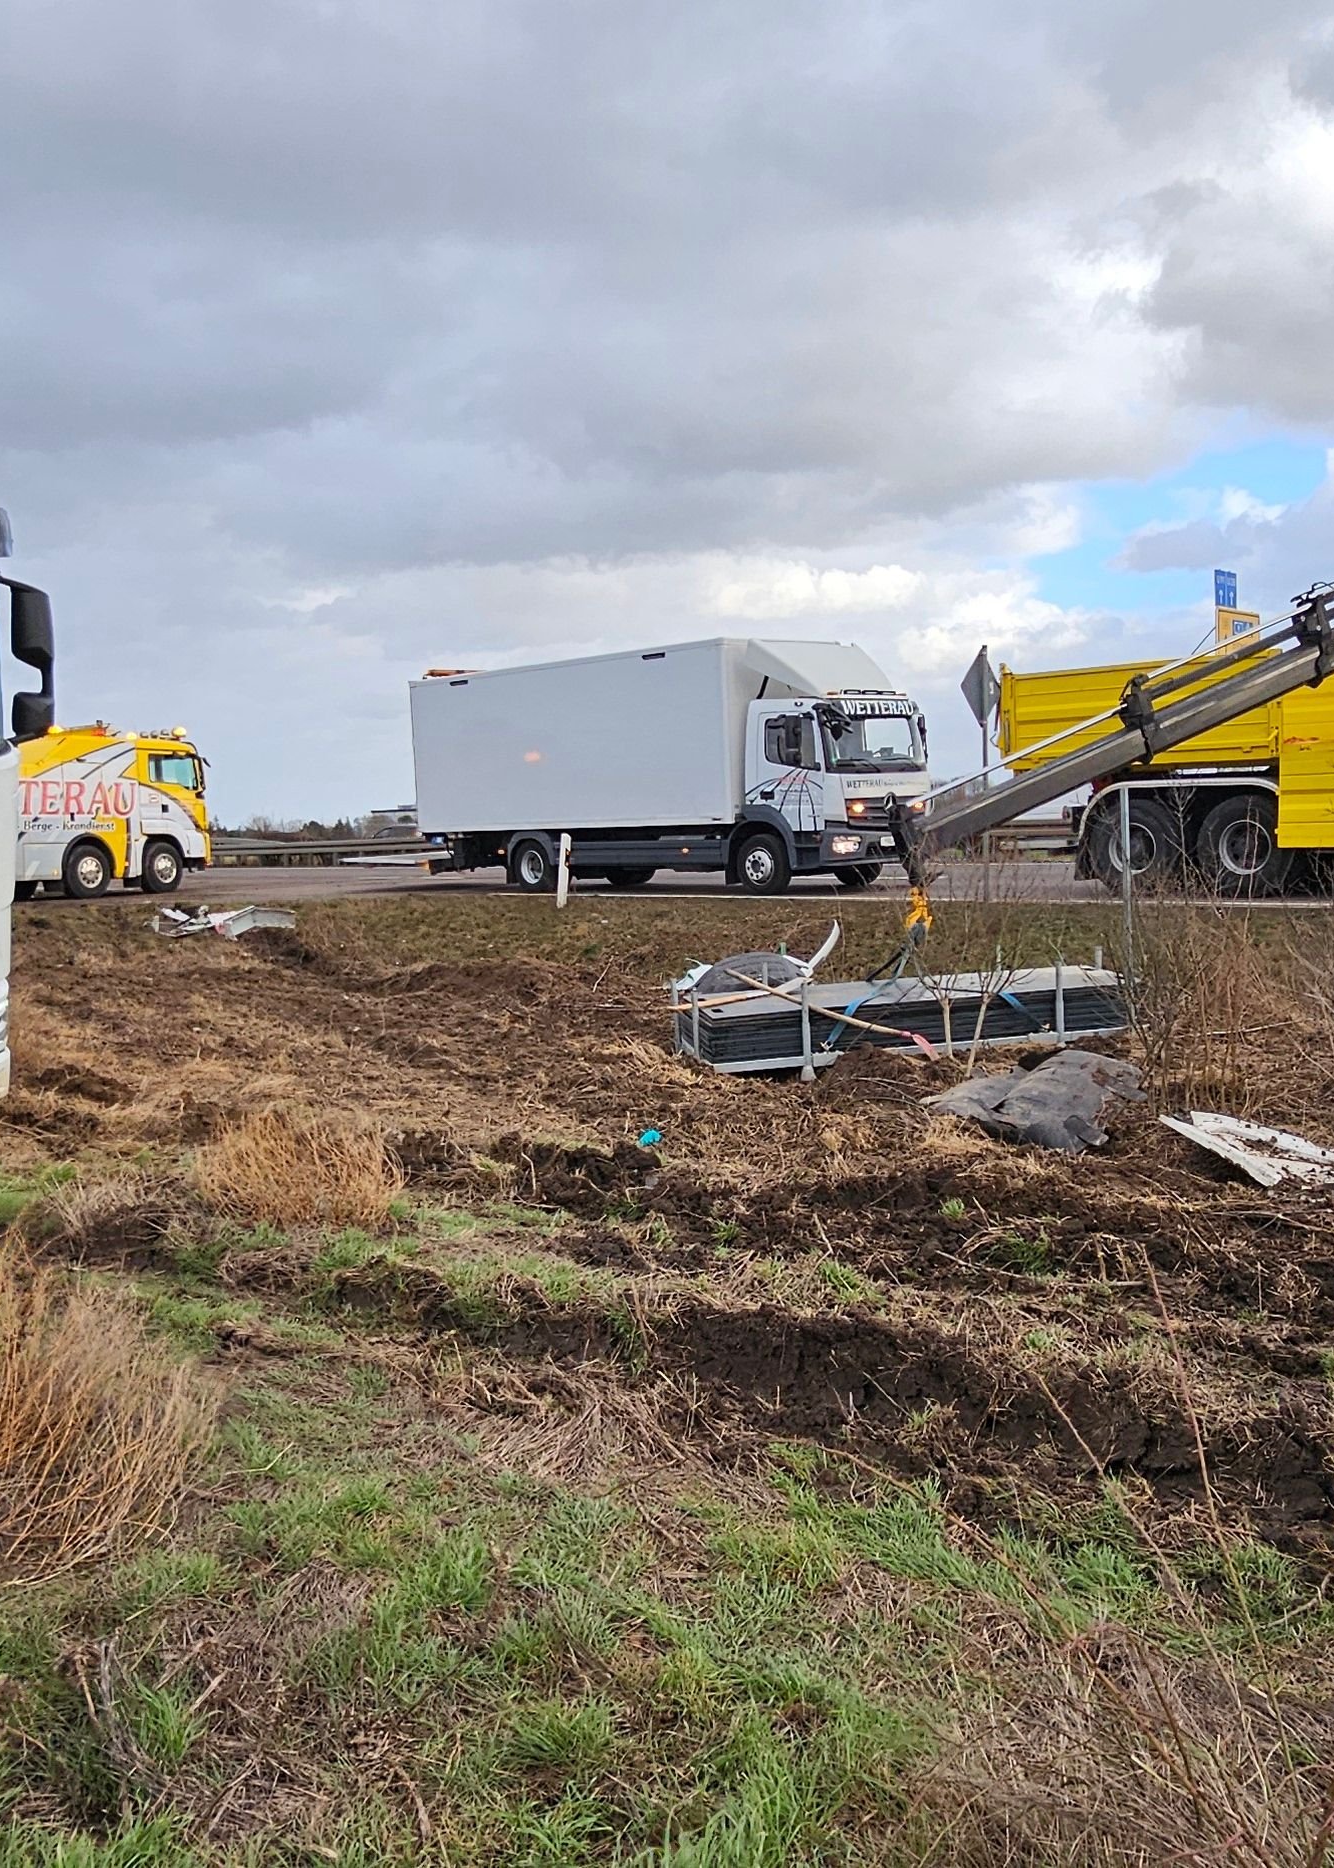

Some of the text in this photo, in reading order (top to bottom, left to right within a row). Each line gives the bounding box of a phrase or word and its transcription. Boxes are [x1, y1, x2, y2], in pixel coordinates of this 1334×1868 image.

[840, 699, 914, 716] WETTERAU
[23, 820, 53, 832] Berge
[62, 820, 115, 832] Krandienst
